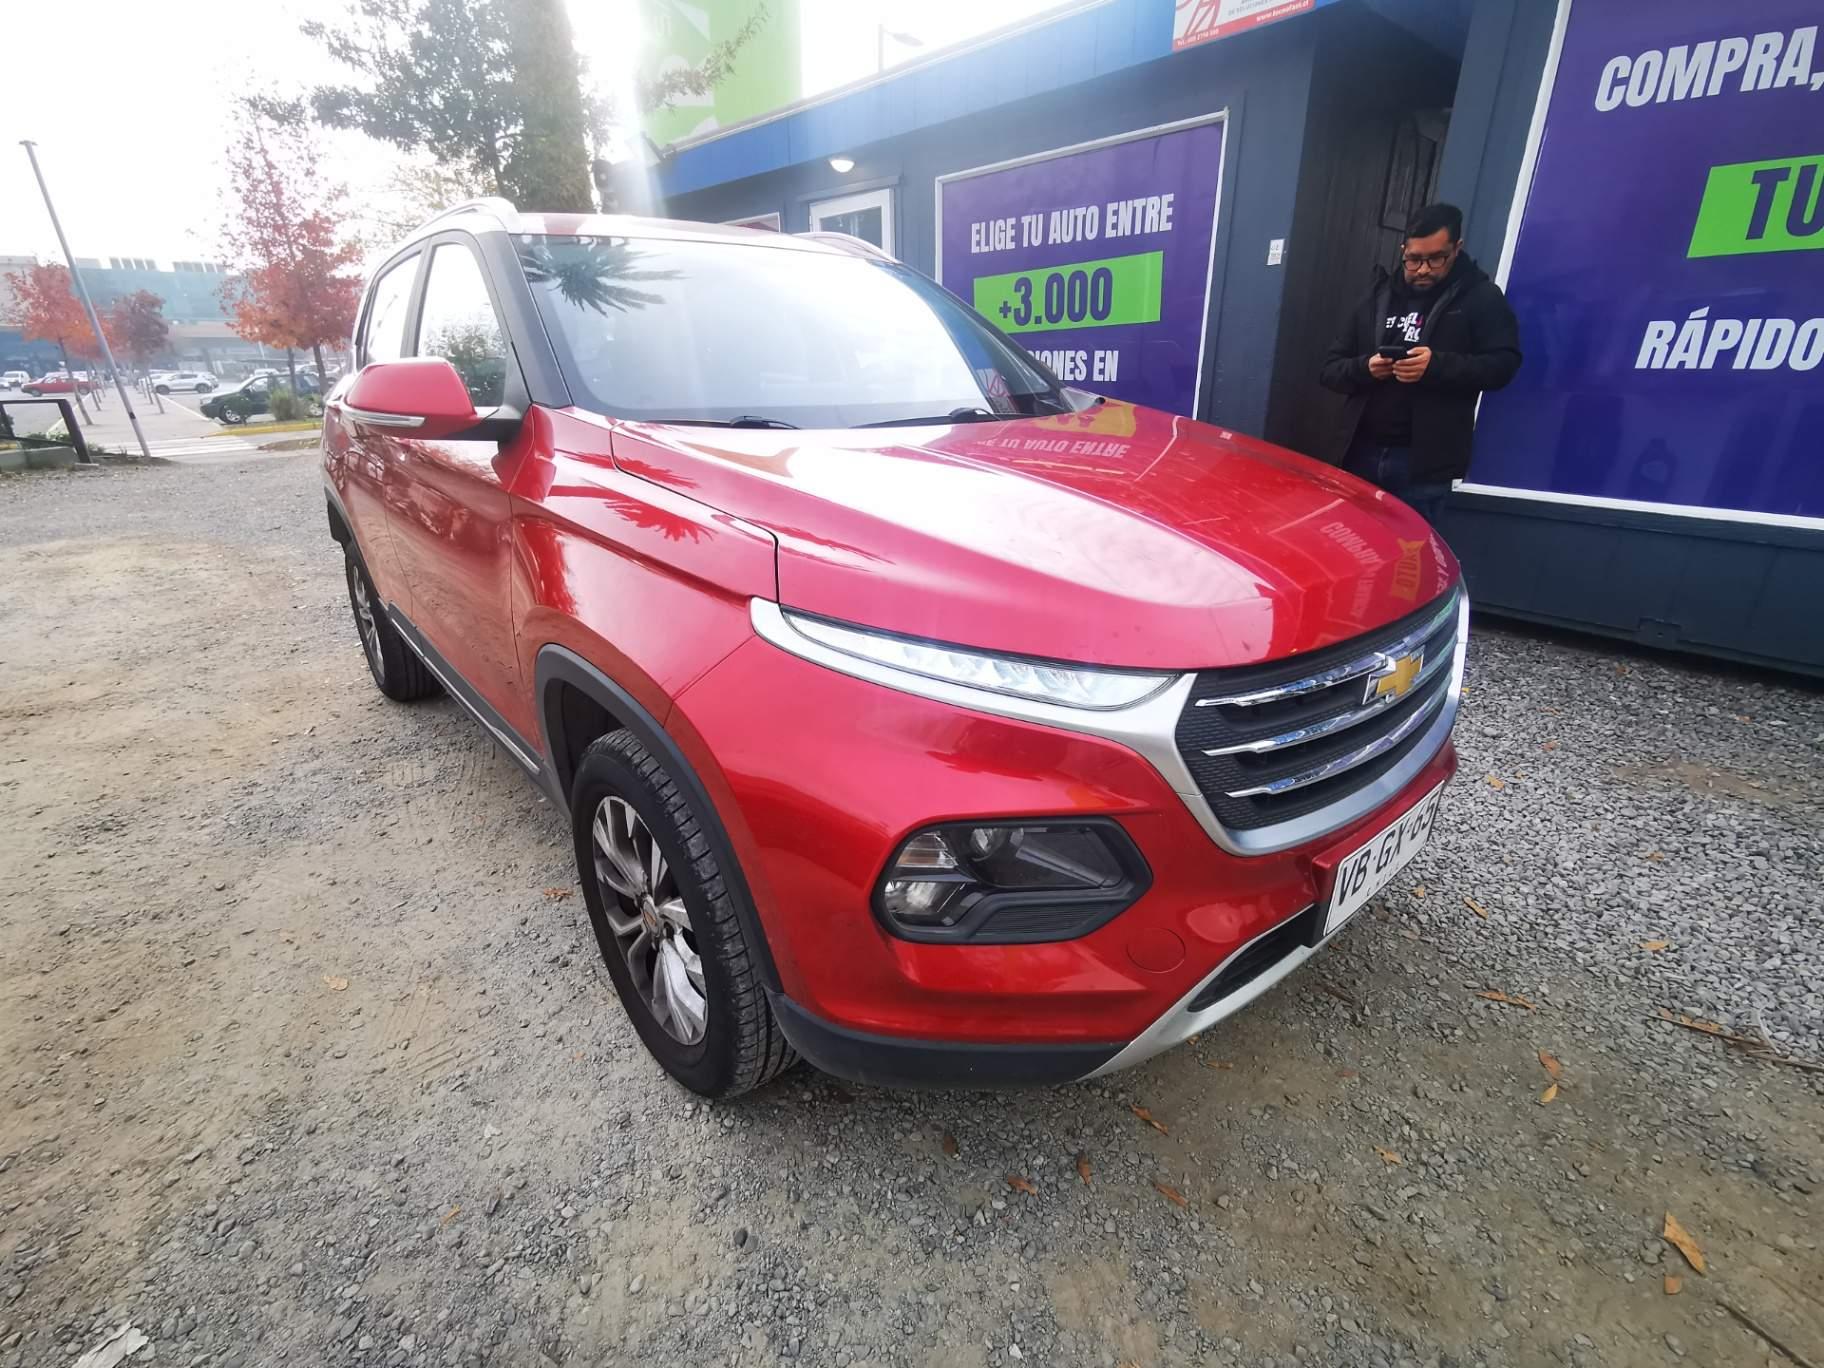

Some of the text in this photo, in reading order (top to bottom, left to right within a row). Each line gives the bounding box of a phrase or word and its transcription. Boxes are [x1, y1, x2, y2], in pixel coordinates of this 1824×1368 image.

[1595, 25, 1824, 112] COMPRA,
[971, 193, 1175, 254] ELIGE TU AUTO ENTRE
[1745, 163, 1824, 240] TU
[999, 266, 1114, 327] +3.000
[1093, 350, 1119, 382] EN
[1634, 306, 1824, 371] RÁPIDO
